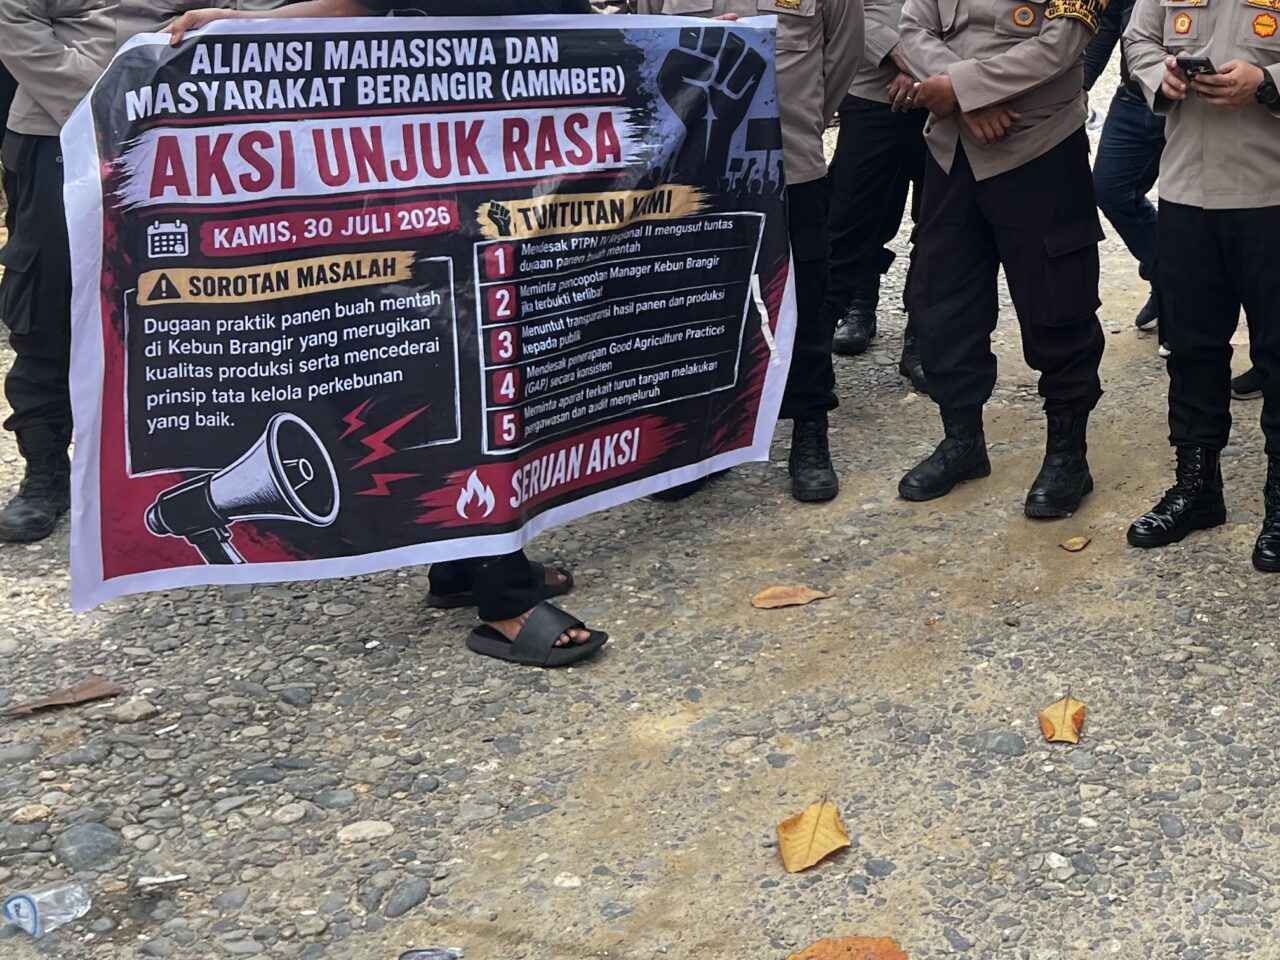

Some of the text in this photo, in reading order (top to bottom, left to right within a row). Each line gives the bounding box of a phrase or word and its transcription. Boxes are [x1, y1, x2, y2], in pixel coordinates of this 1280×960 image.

[190, 36, 559, 75] ALIANSI MAHASISWA DAN
[125, 65, 626, 121] MASYARAKAT BERANGIR (AMMBER)
[149, 111, 622, 199] AKSI UNJUK RASA
[213, 206, 451, 249] KAMIS, 30 JULI 2026
[517, 190, 673, 231] TUNTUTAN KAMI
[556, 254, 586, 270] panen
[606, 241, 641, 257] mentah
[571, 236, 599, 251] PTPN
[645, 225, 652, 236] II
[654, 220, 702, 237] mengusut
[704, 219, 734, 231] tuntas
[188, 256, 397, 298] SOROTAN MASALAH
[494, 247, 506, 274] 1
[520, 255, 720, 297] Meminta pencopotan Manager Kebun Brangir
[144, 290, 441, 342] Dugaan praktik panen buah mentah
[495, 289, 510, 317] 2
[521, 288, 726, 339] Menuntut transparansi hasil panen dan produksi
[535, 291, 570, 310] terbukti
[144, 315, 431, 361] di Kebun Brangir yang merugikan
[498, 331, 513, 359] 3
[522, 336, 557, 355] kepada
[526, 325, 725, 379] Mendesak penerapan Good Agriculture Practices
[145, 337, 440, 382] kualitas produksi serta mencederai
[524, 361, 613, 397] (GAP) secara konsisten
[146, 368, 404, 411] prinsip tata kelola perkebunan
[500, 372, 515, 399] 4
[558, 390, 585, 407] aparat
[586, 382, 613, 399] terkait
[613, 378, 636, 390] turun
[638, 370, 670, 385] tangan
[671, 361, 718, 378] melakukan
[146, 410, 235, 435] yang baik.
[501, 413, 516, 441] 5
[524, 412, 570, 438] pengawasan
[572, 406, 586, 418] dan
[609, 385, 661, 408] menyeluruh
[509, 427, 640, 509] SERUAN AKSI
